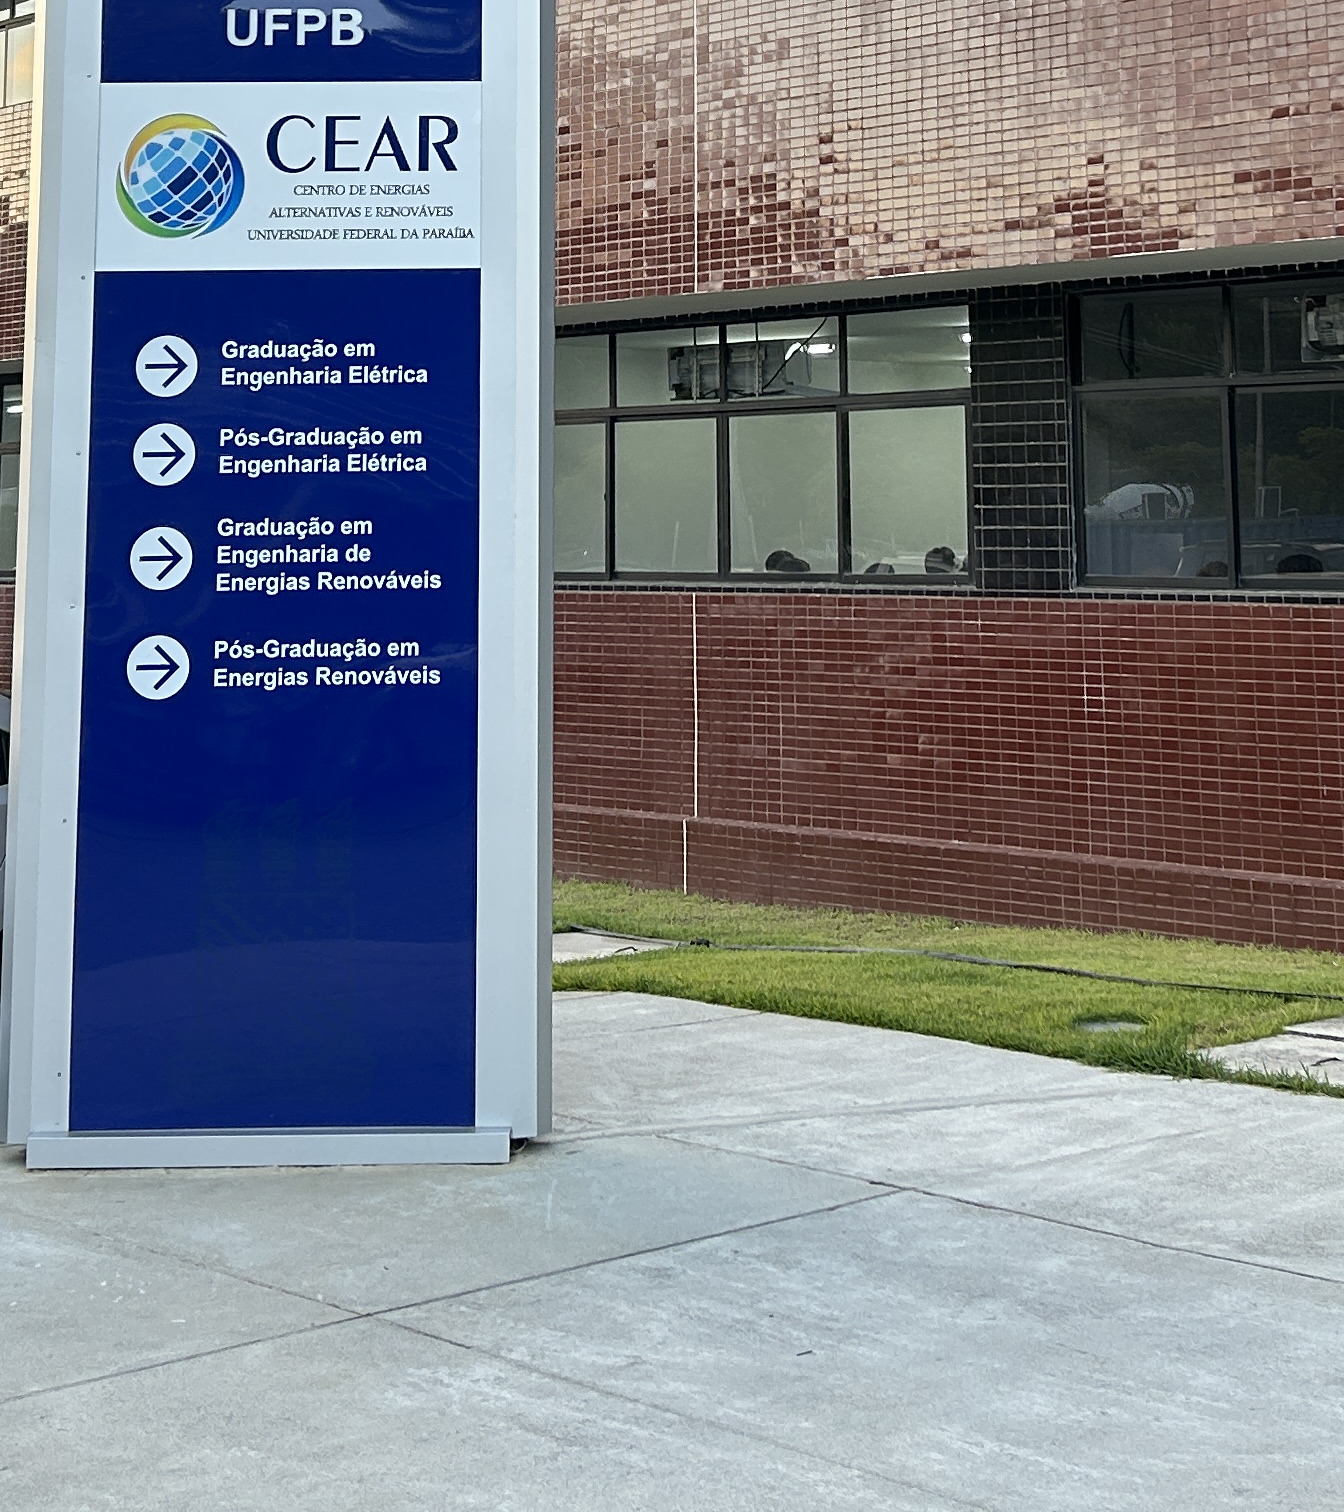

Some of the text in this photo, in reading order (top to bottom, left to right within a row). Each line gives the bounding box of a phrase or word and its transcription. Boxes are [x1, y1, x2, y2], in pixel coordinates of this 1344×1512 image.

[226, 8, 365, 47] UFPB
[266, 114, 459, 174] CEAR
[293, 183, 431, 196] CENTRO DE ENERGIAS
[268, 203, 454, 218] ALTERNATIVAS E RENOVÁVEIS
[247, 226, 476, 240] UNIVERSIDADE FEDERAL DA PARAÍBA
[221, 338, 376, 361] Graduação em
[221, 364, 428, 392] Engenharia Elétrica
[219, 426, 422, 450] Pós-Graduação em
[218, 451, 427, 478] Engenharia Elétrica
[217, 516, 373, 540] Graduação em
[216, 543, 371, 569] Engenharia de
[216, 568, 442, 596] Energias Renováveis
[214, 638, 420, 662] Pós-Graduação em
[213, 664, 441, 690] Energias Renováveis
